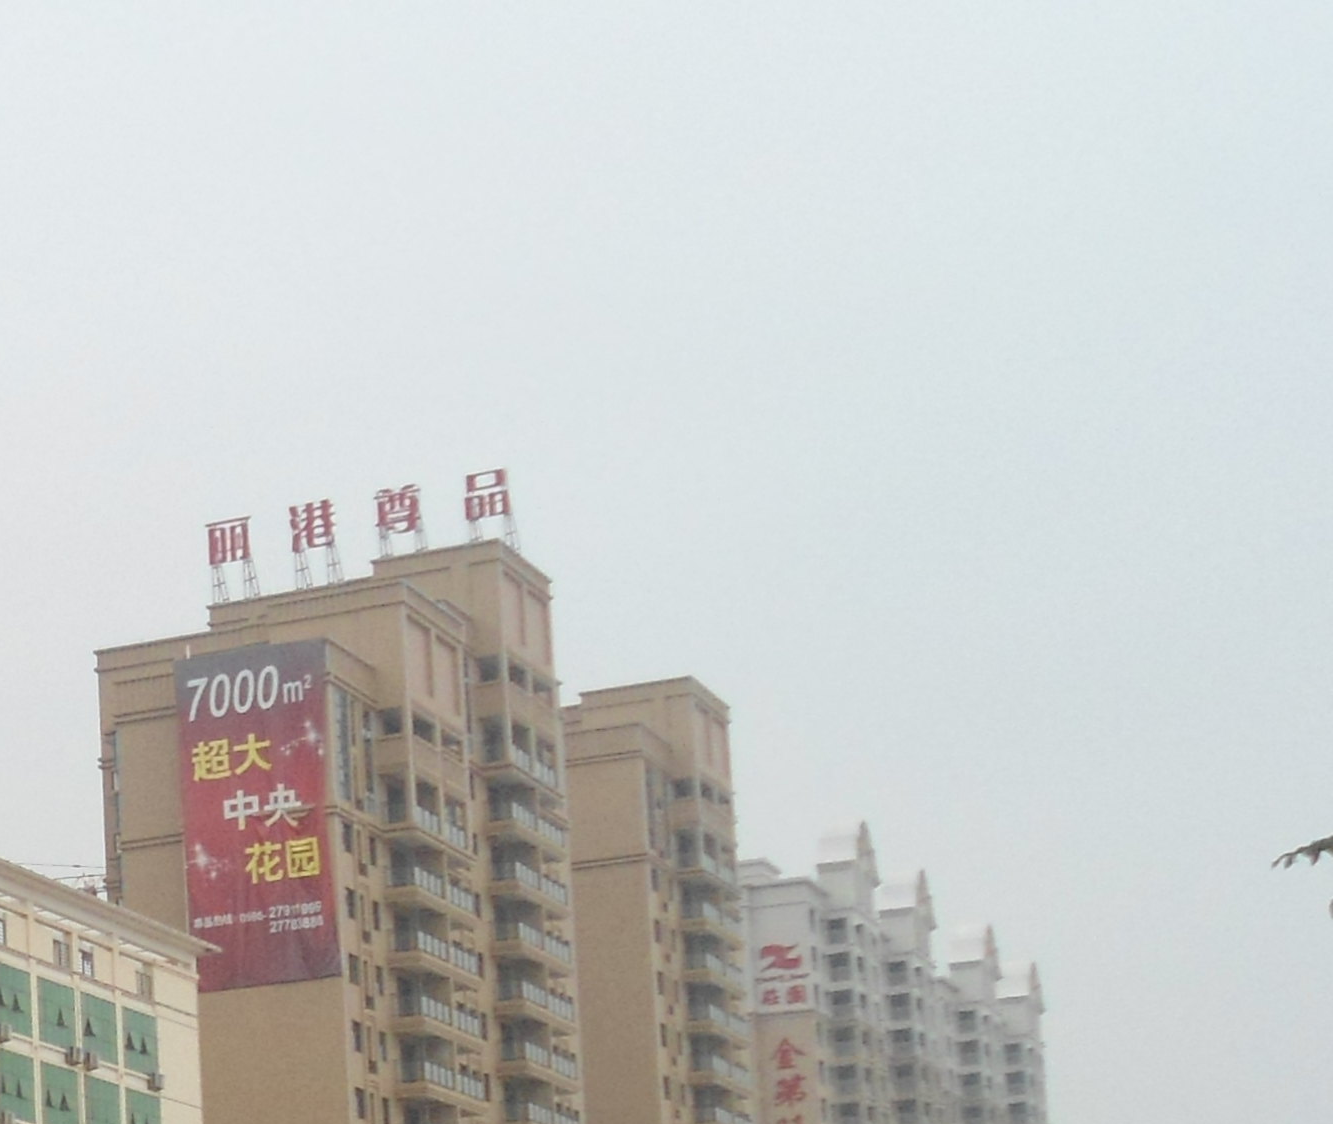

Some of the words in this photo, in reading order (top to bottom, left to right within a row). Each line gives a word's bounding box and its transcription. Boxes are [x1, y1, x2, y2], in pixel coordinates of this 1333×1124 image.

[205, 468, 510, 566] 丽港尊品
[191, 733, 272, 782] 超大
[223, 783, 303, 831] 中央
[245, 836, 321, 885] 花园
